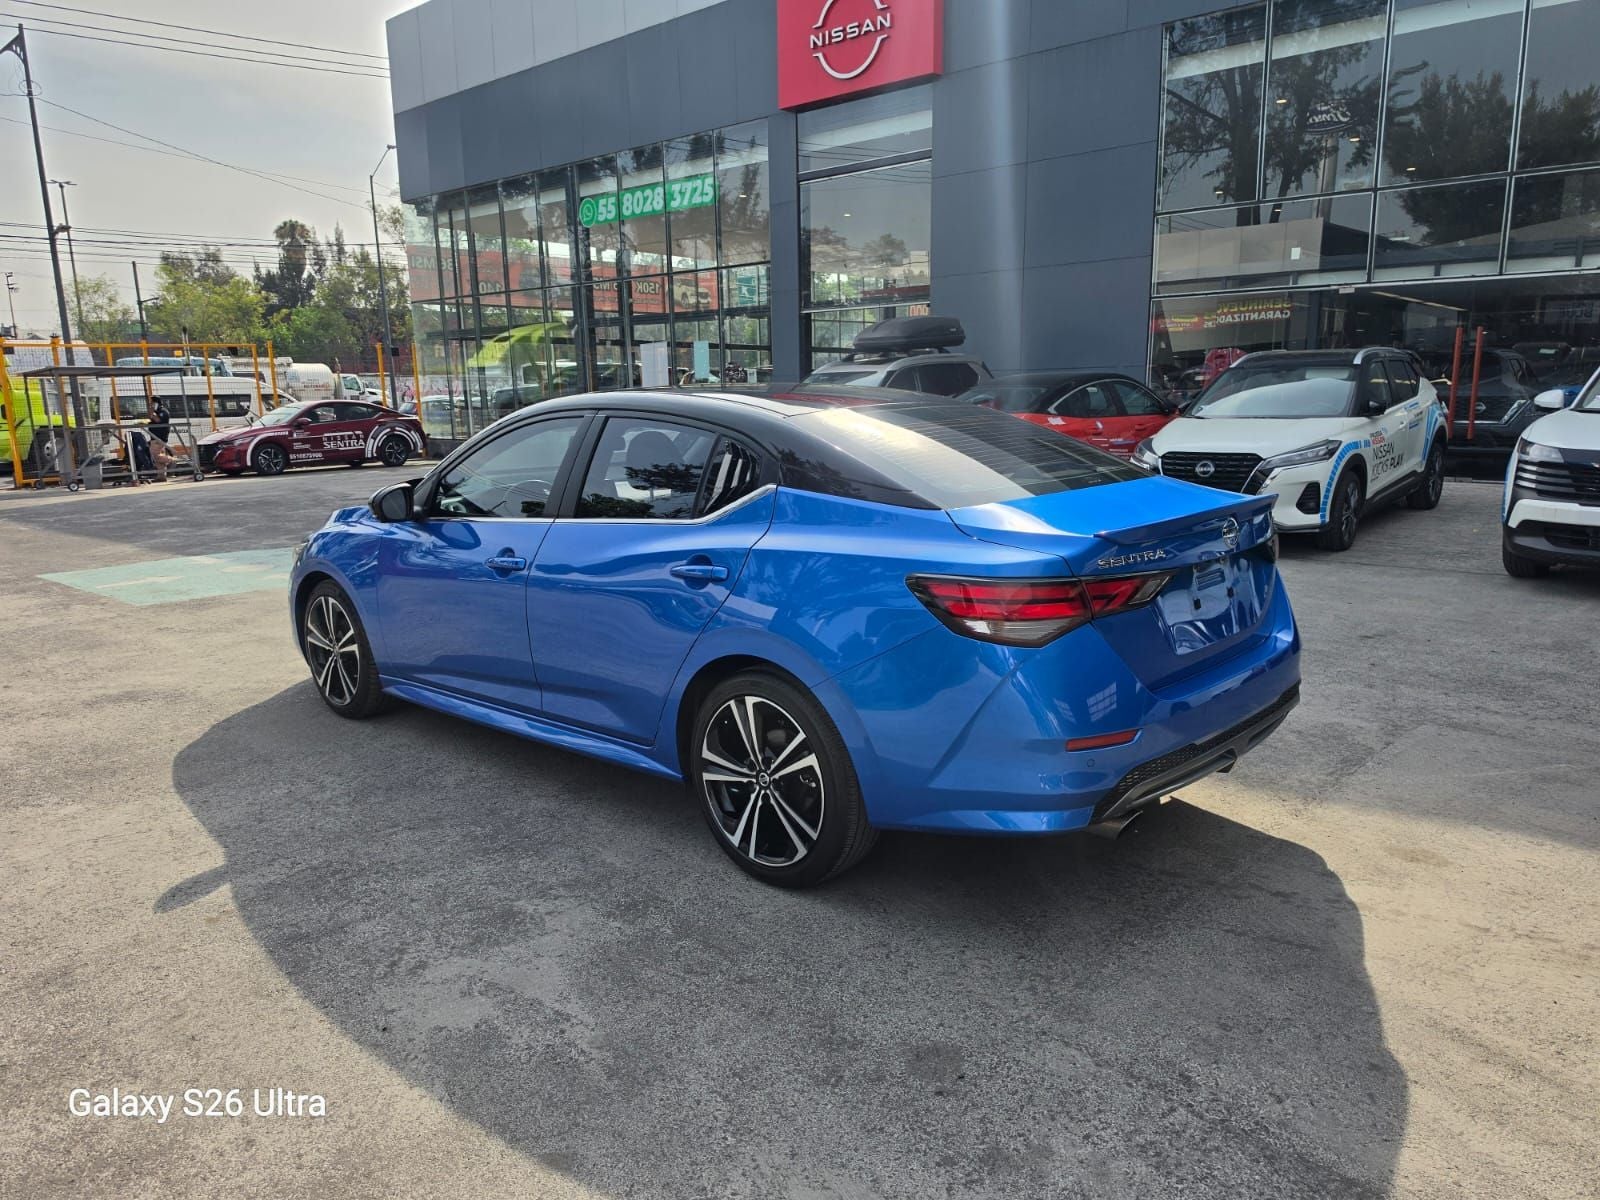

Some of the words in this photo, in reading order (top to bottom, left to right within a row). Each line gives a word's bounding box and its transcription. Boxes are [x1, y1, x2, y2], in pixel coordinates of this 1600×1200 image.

[810, 12, 890, 49] NISSAN
[598, 196, 617, 221] 55
[622, 187, 666, 216] 8028
[670, 177, 714, 208] 3725
[322, 440, 365, 449] SENTRA
[1372, 441, 1394, 460] NISSAN
[1097, 549, 1166, 569] SENTRA
